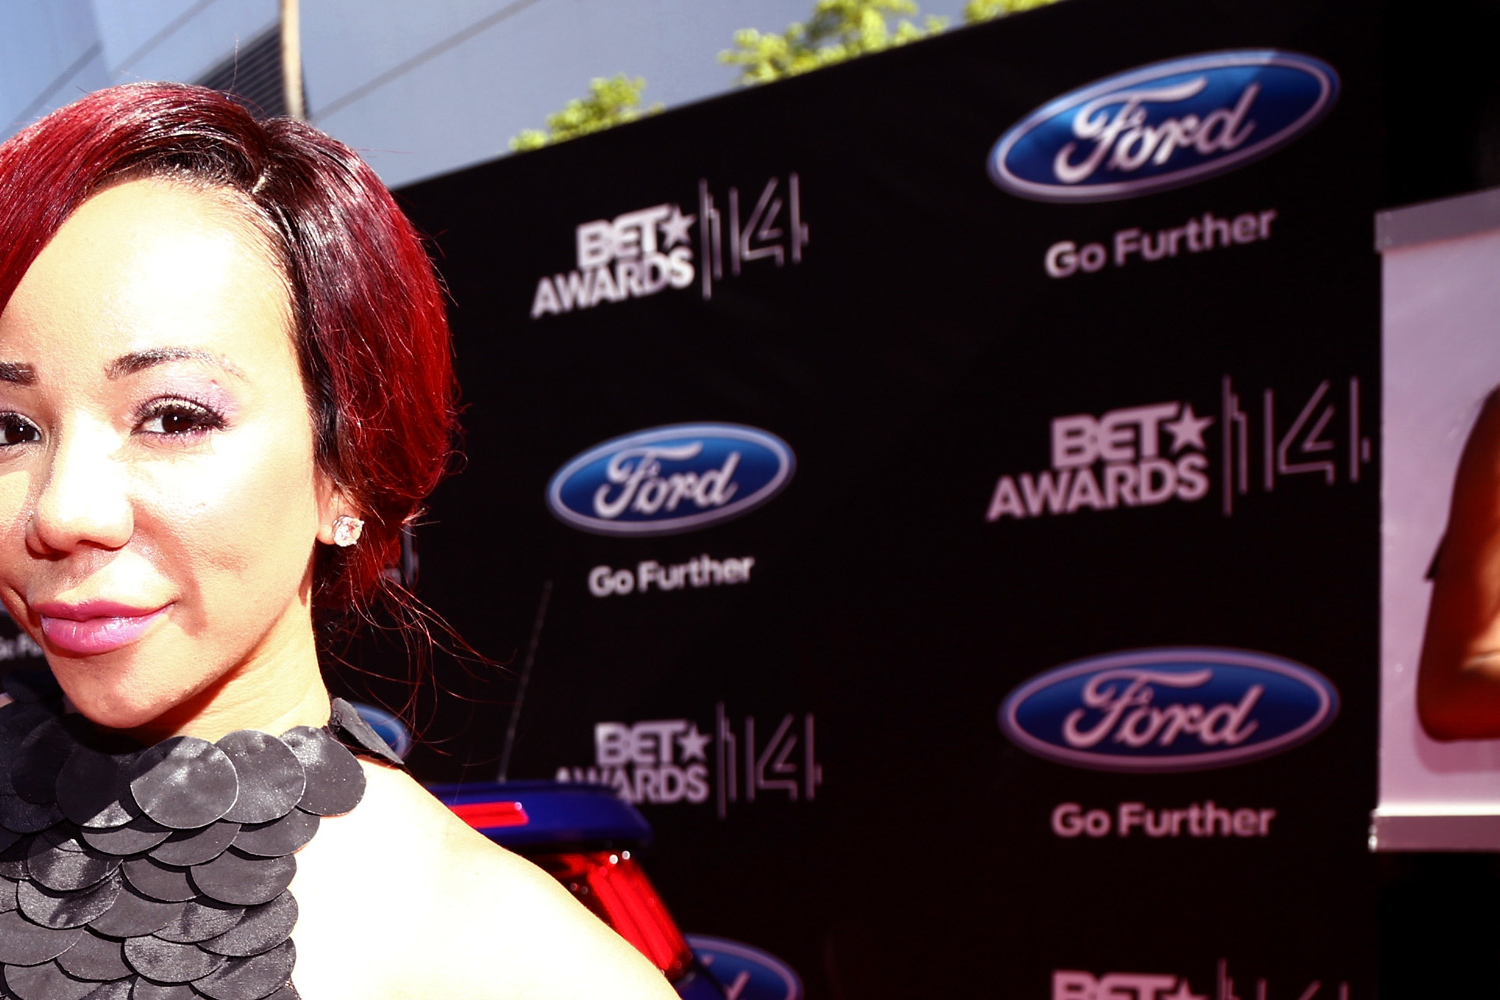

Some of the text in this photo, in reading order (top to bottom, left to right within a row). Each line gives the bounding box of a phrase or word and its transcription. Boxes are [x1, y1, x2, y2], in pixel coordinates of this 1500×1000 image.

[1054, 76, 1260, 183] Ford
[576, 203, 672, 271] BET
[1044, 209, 1277, 278] Go Further
[530, 247, 695, 318] AWARDS
[1051, 402, 1180, 470] BET
[593, 442, 741, 519] Ford
[986, 453, 1209, 521] AWARDS
[588, 554, 756, 597] Go Further
[1062, 667, 1264, 747] Ford
[594, 719, 688, 765] BET
[1052, 800, 1276, 837] Go Further
